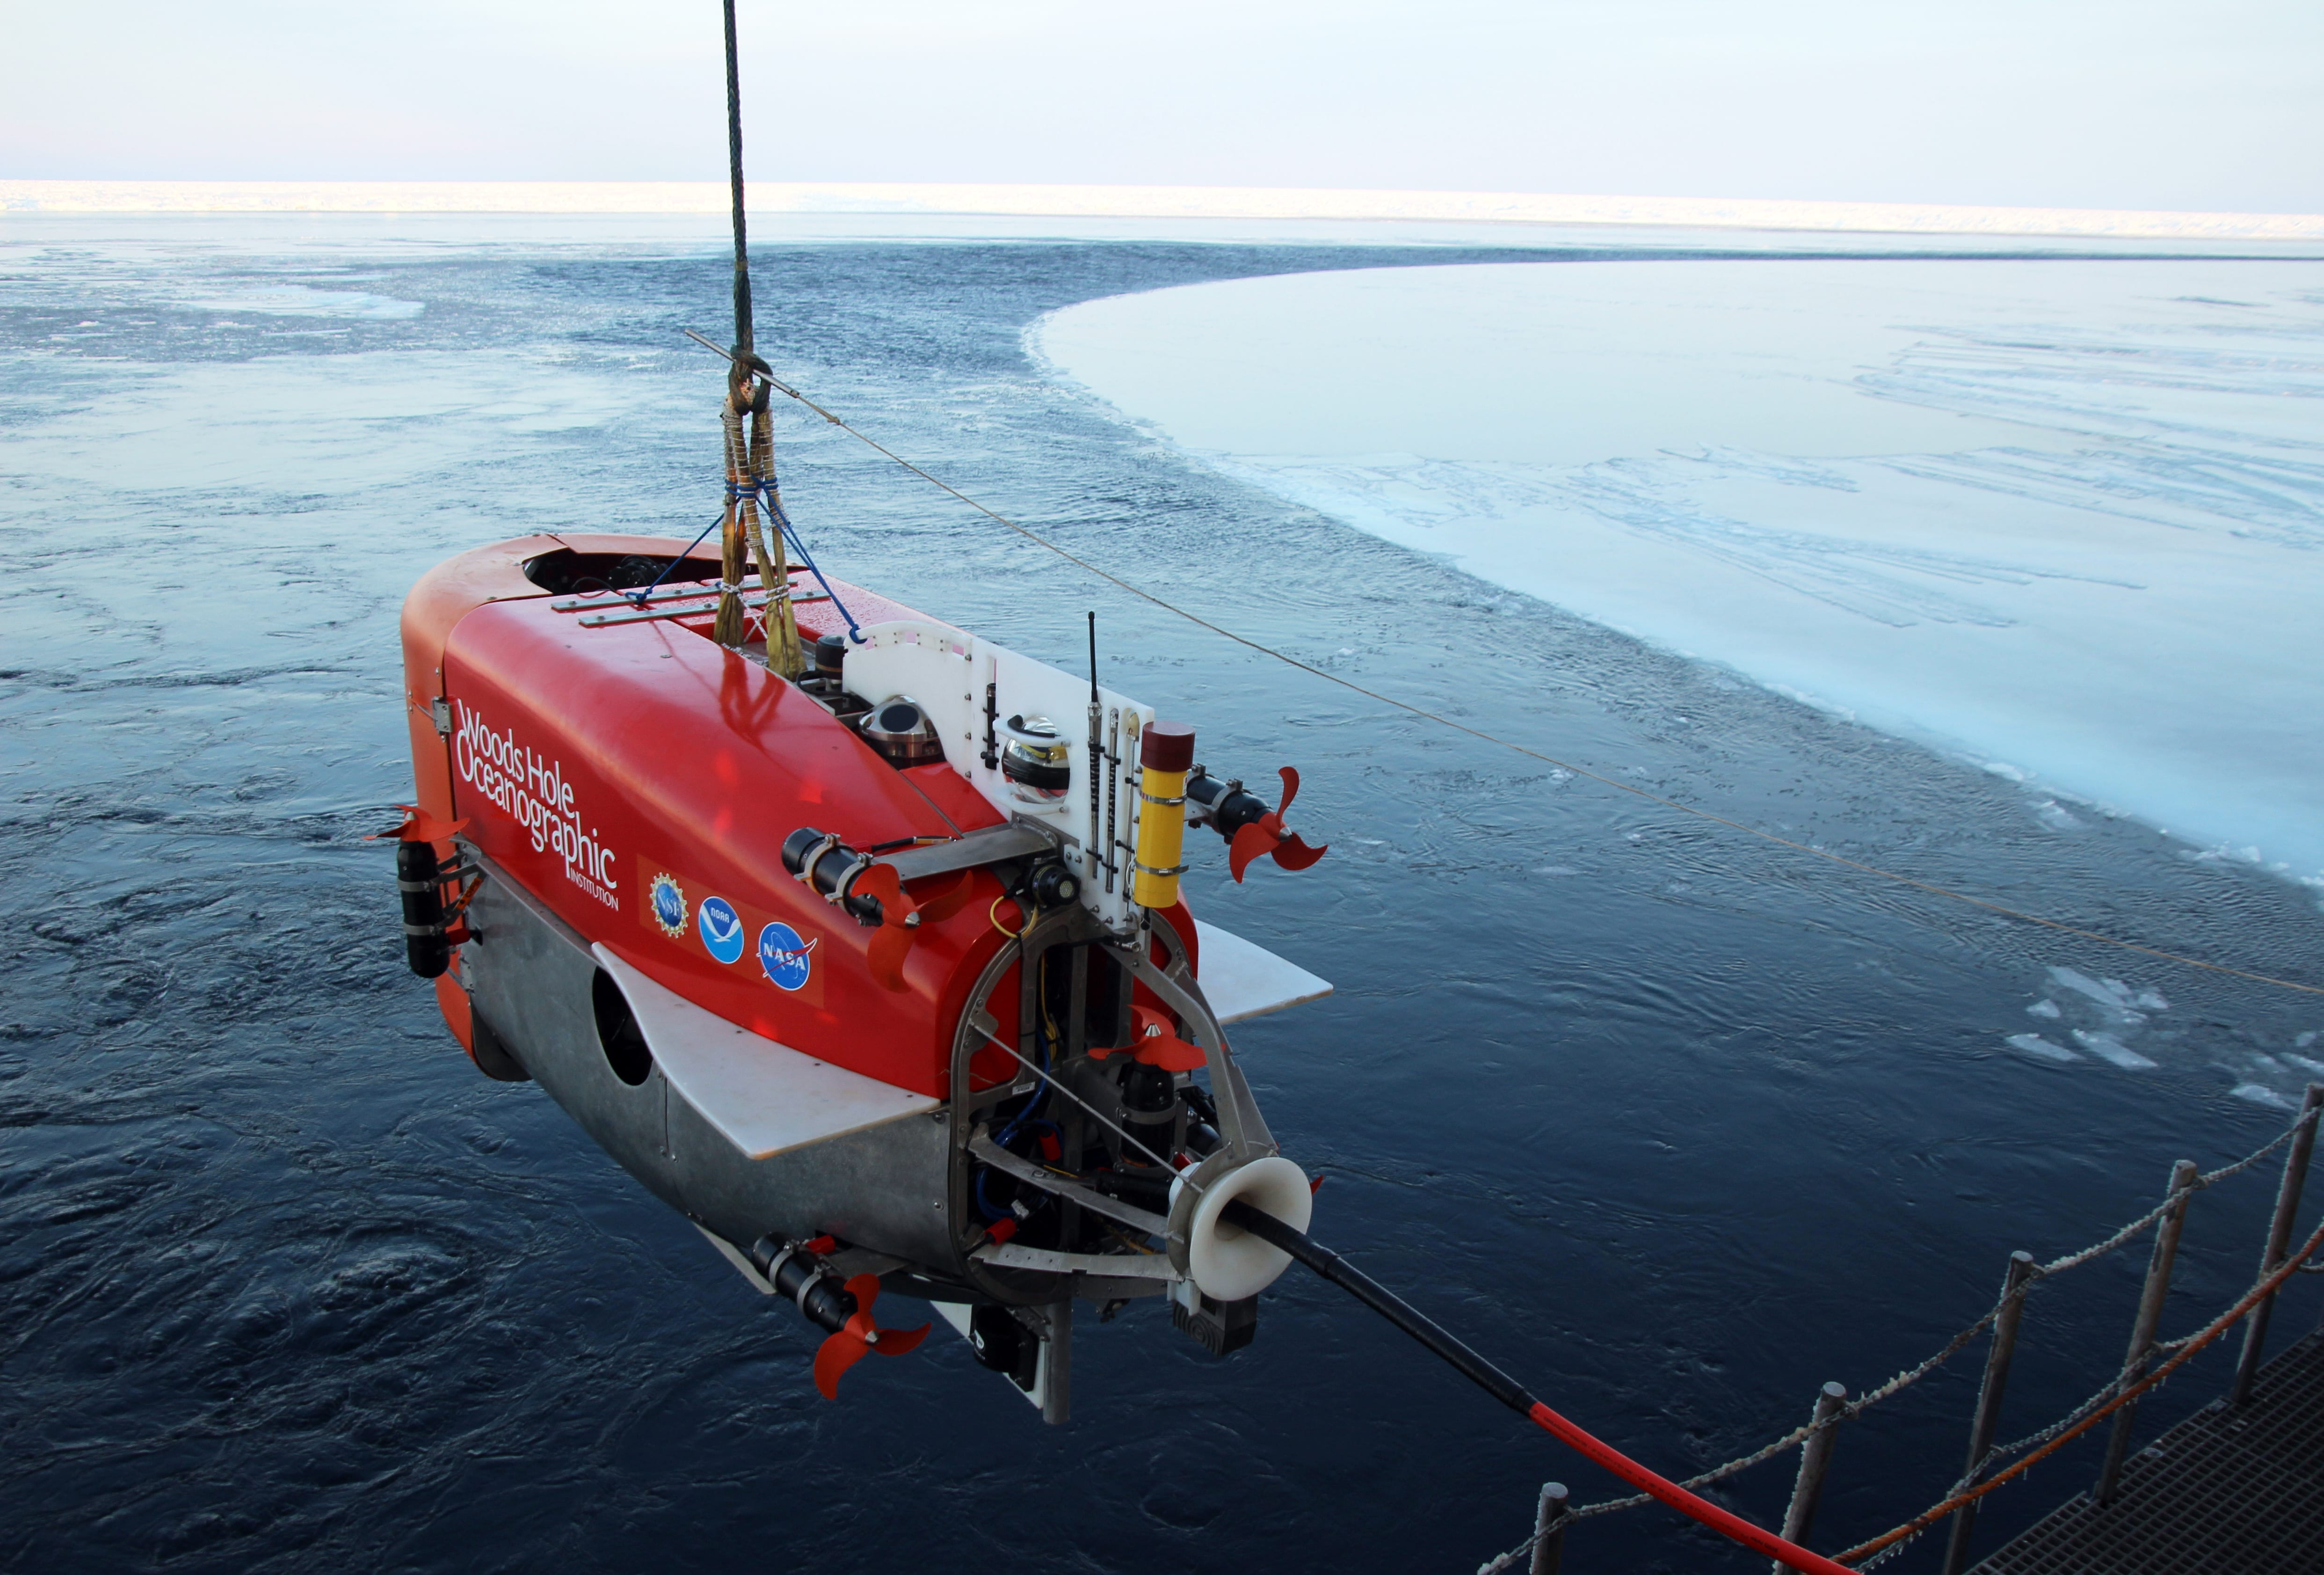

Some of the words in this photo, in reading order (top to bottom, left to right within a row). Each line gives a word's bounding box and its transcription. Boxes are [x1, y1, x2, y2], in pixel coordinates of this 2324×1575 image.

[458, 698, 524, 782] Woods
[527, 746, 575, 819] Hole
[1090, 751, 1100, 812] OVATECH
[457, 729, 617, 889] Oceanographic
[570, 867, 619, 912] INSTITUTION
[657, 892, 680, 916] NSF
[763, 942, 806, 970] NASA
